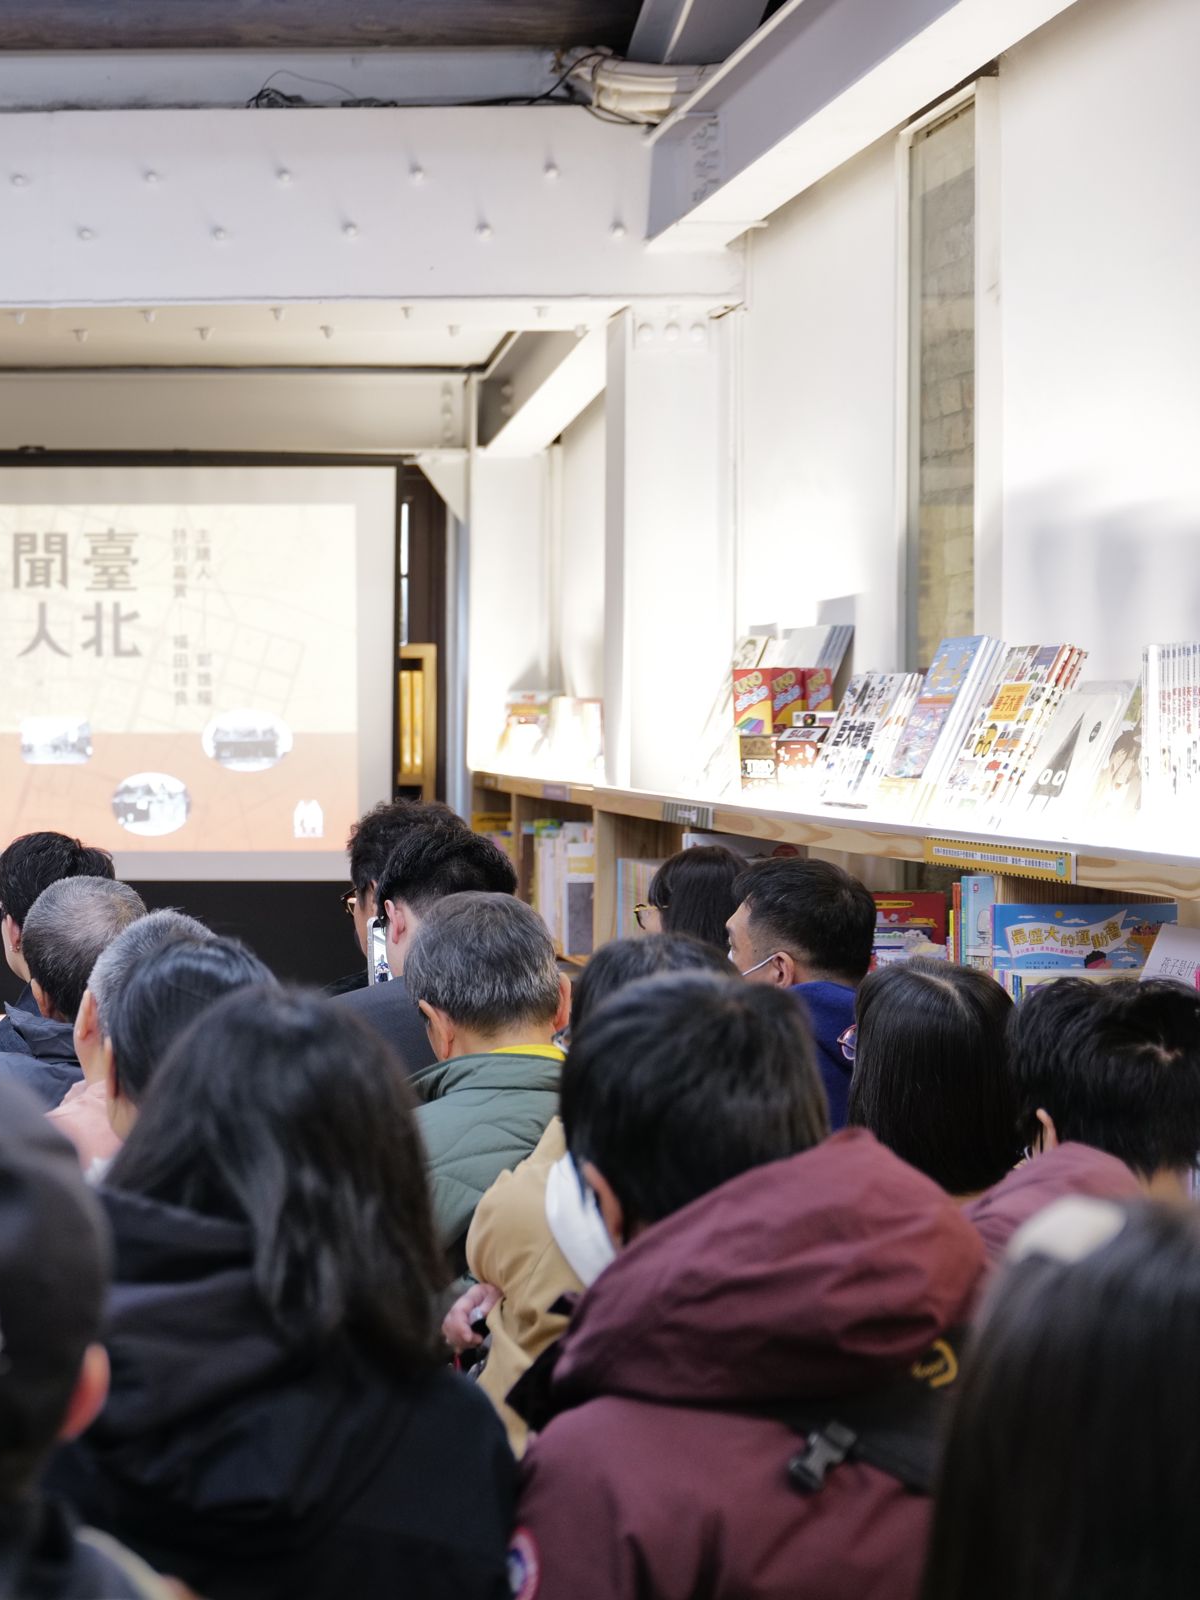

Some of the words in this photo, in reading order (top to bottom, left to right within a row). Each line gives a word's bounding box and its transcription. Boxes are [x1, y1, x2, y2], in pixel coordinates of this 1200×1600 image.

[12, 531, 71, 657] 聞人
[81, 528, 142, 657] 臺北
[1160, 957, 1200, 977] 孩子是什
